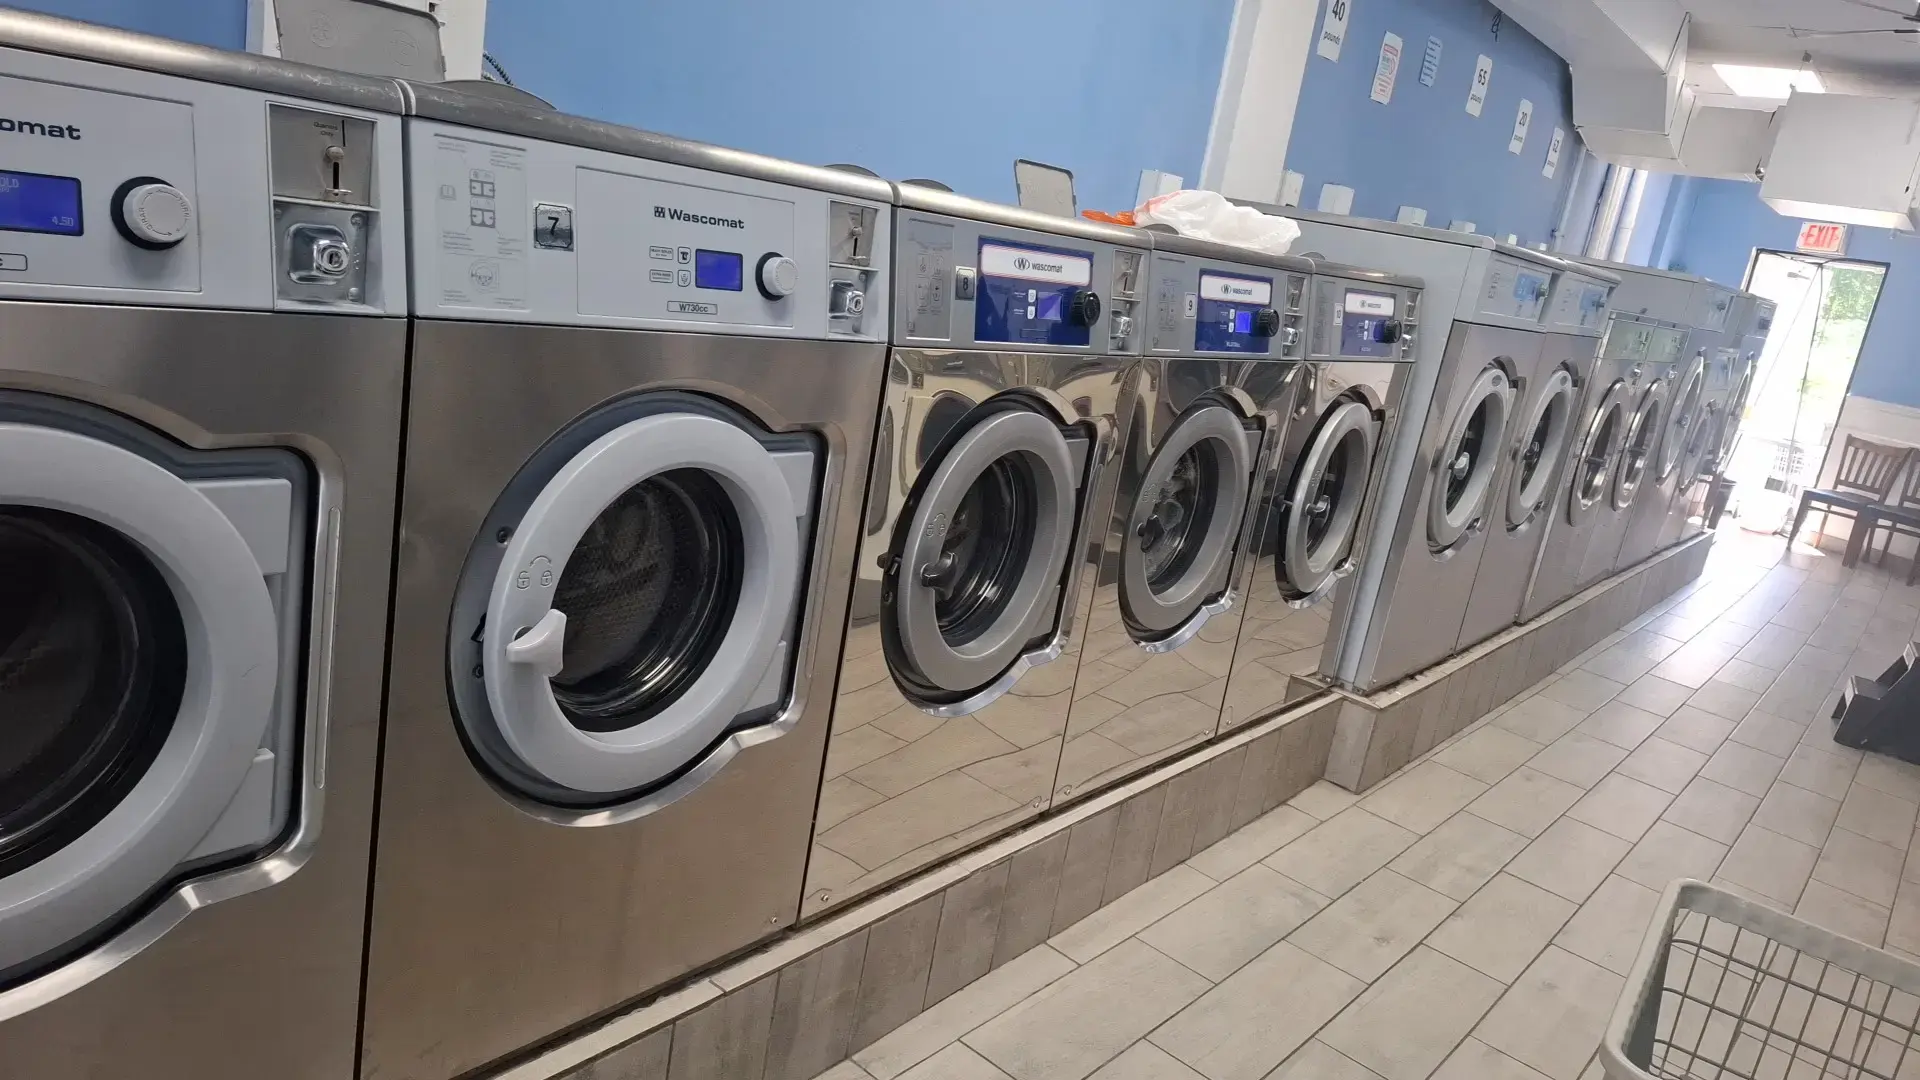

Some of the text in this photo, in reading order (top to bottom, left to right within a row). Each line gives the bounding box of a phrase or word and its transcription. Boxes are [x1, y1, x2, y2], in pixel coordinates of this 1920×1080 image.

[1332, 0, 1346, 22] 40
[1323, 31, 1341, 45] pounds
[1477, 68, 1488, 86] 65
[668, 207, 745, 229] Wascomat
[547, 216, 561, 235] 7
[1804, 224, 1839, 248] EXIT
[1031, 262, 1063, 273] wascomat
[962, 278, 969, 291] 8
[1232, 287, 1253, 296] wascomat
[679, 303, 709, 313] W730cc
[1188, 300, 1193, 311] 9
